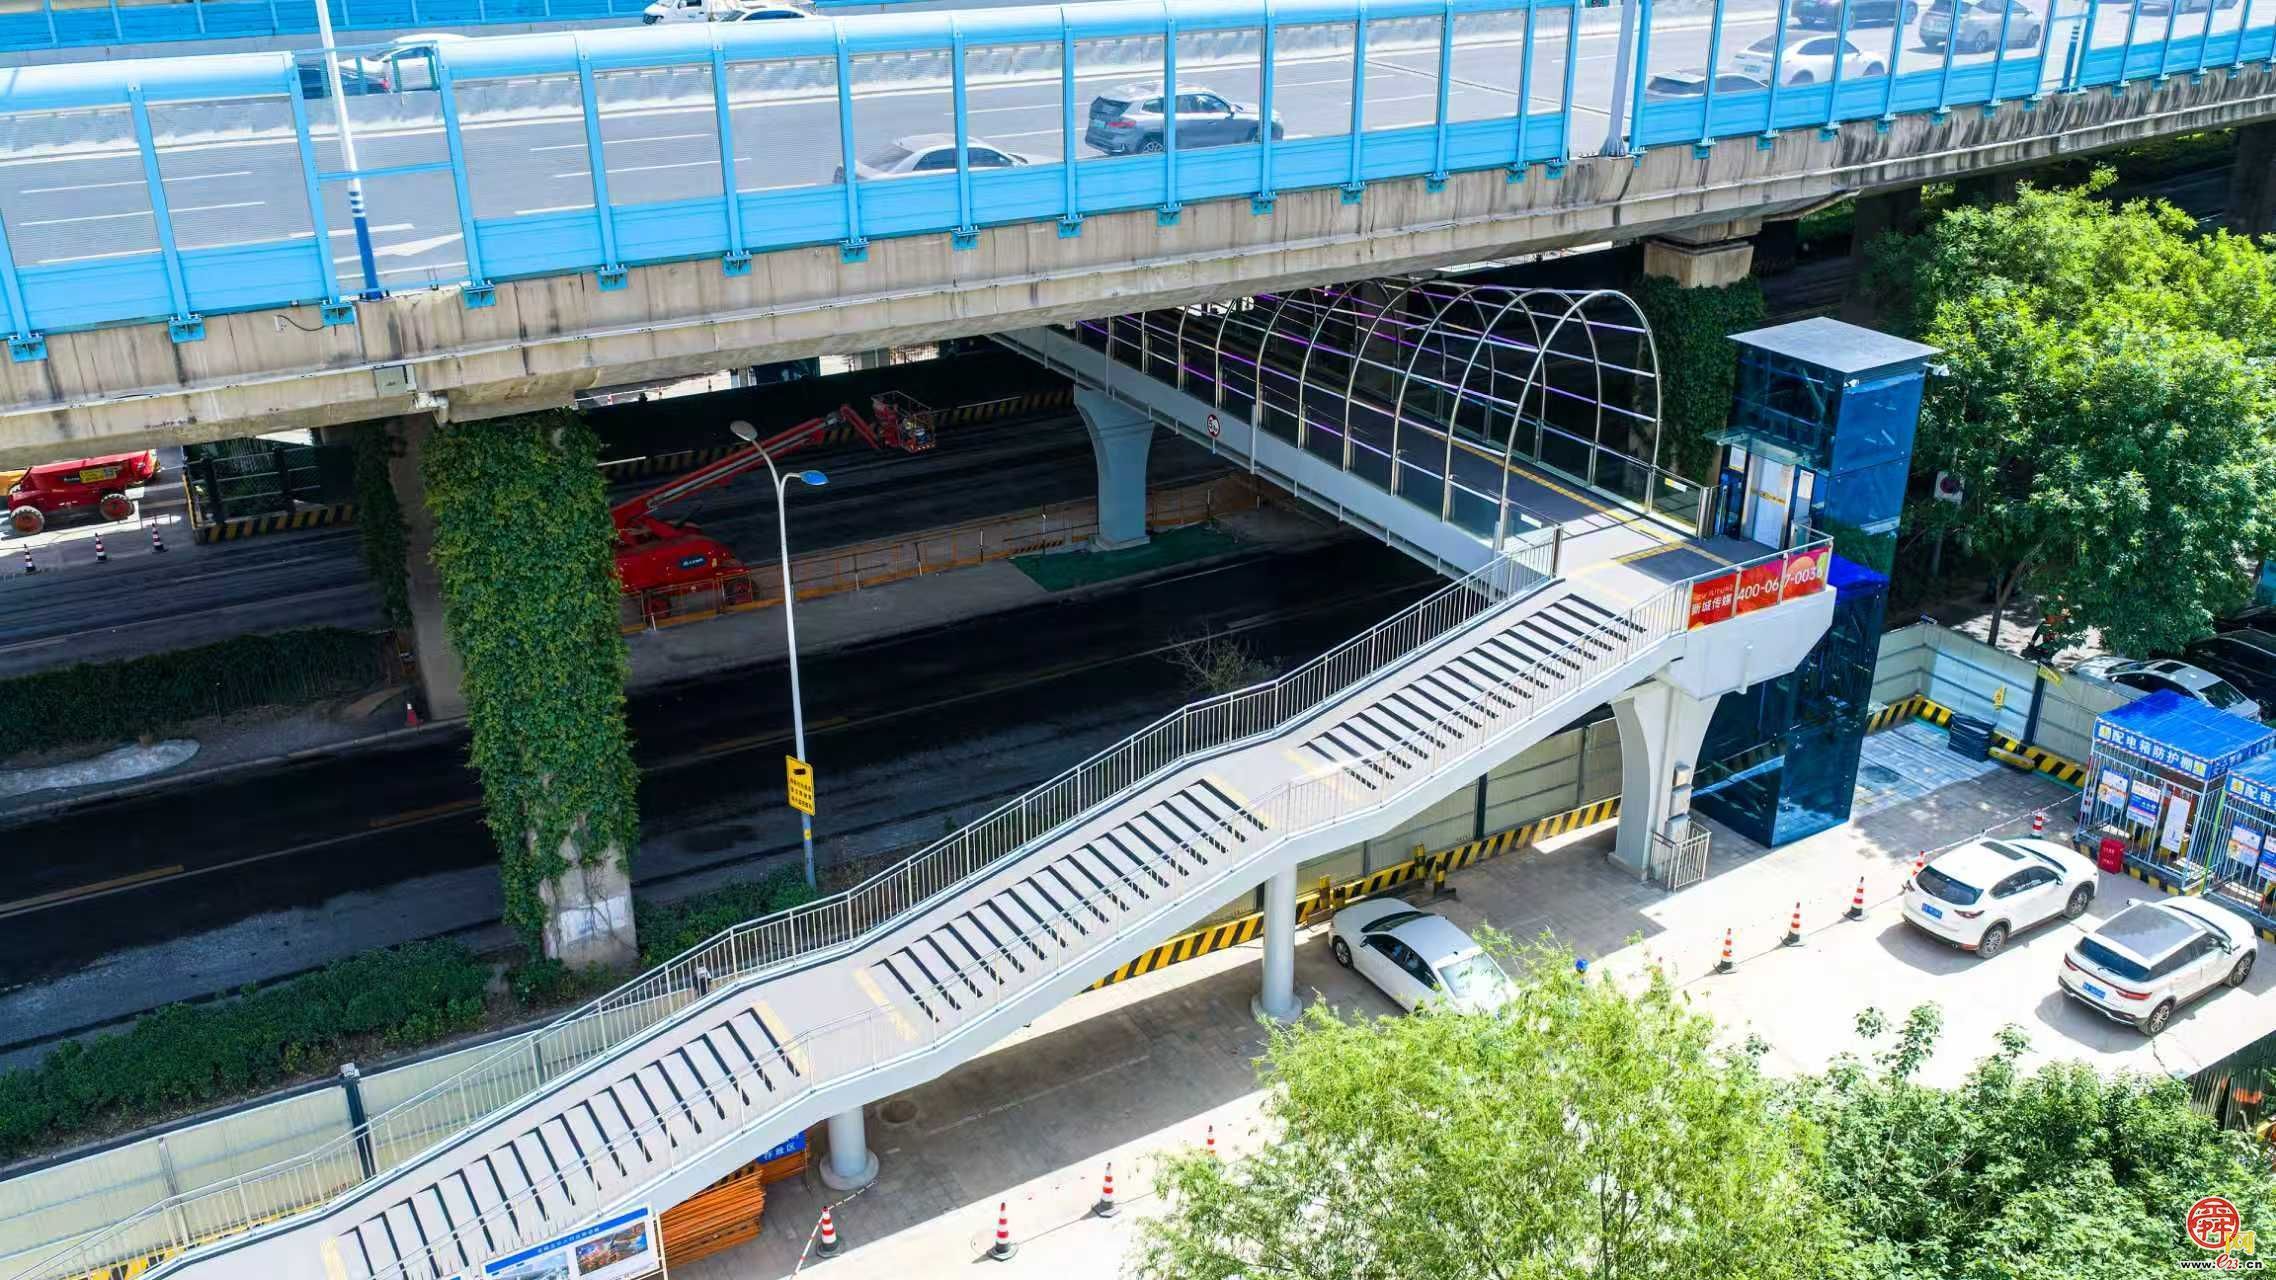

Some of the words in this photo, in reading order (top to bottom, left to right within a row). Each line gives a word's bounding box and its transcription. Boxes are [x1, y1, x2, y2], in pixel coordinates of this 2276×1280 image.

[2112, 728, 2192, 771] 配电箱防护棚
[2245, 783, 2276, 808] 配电
